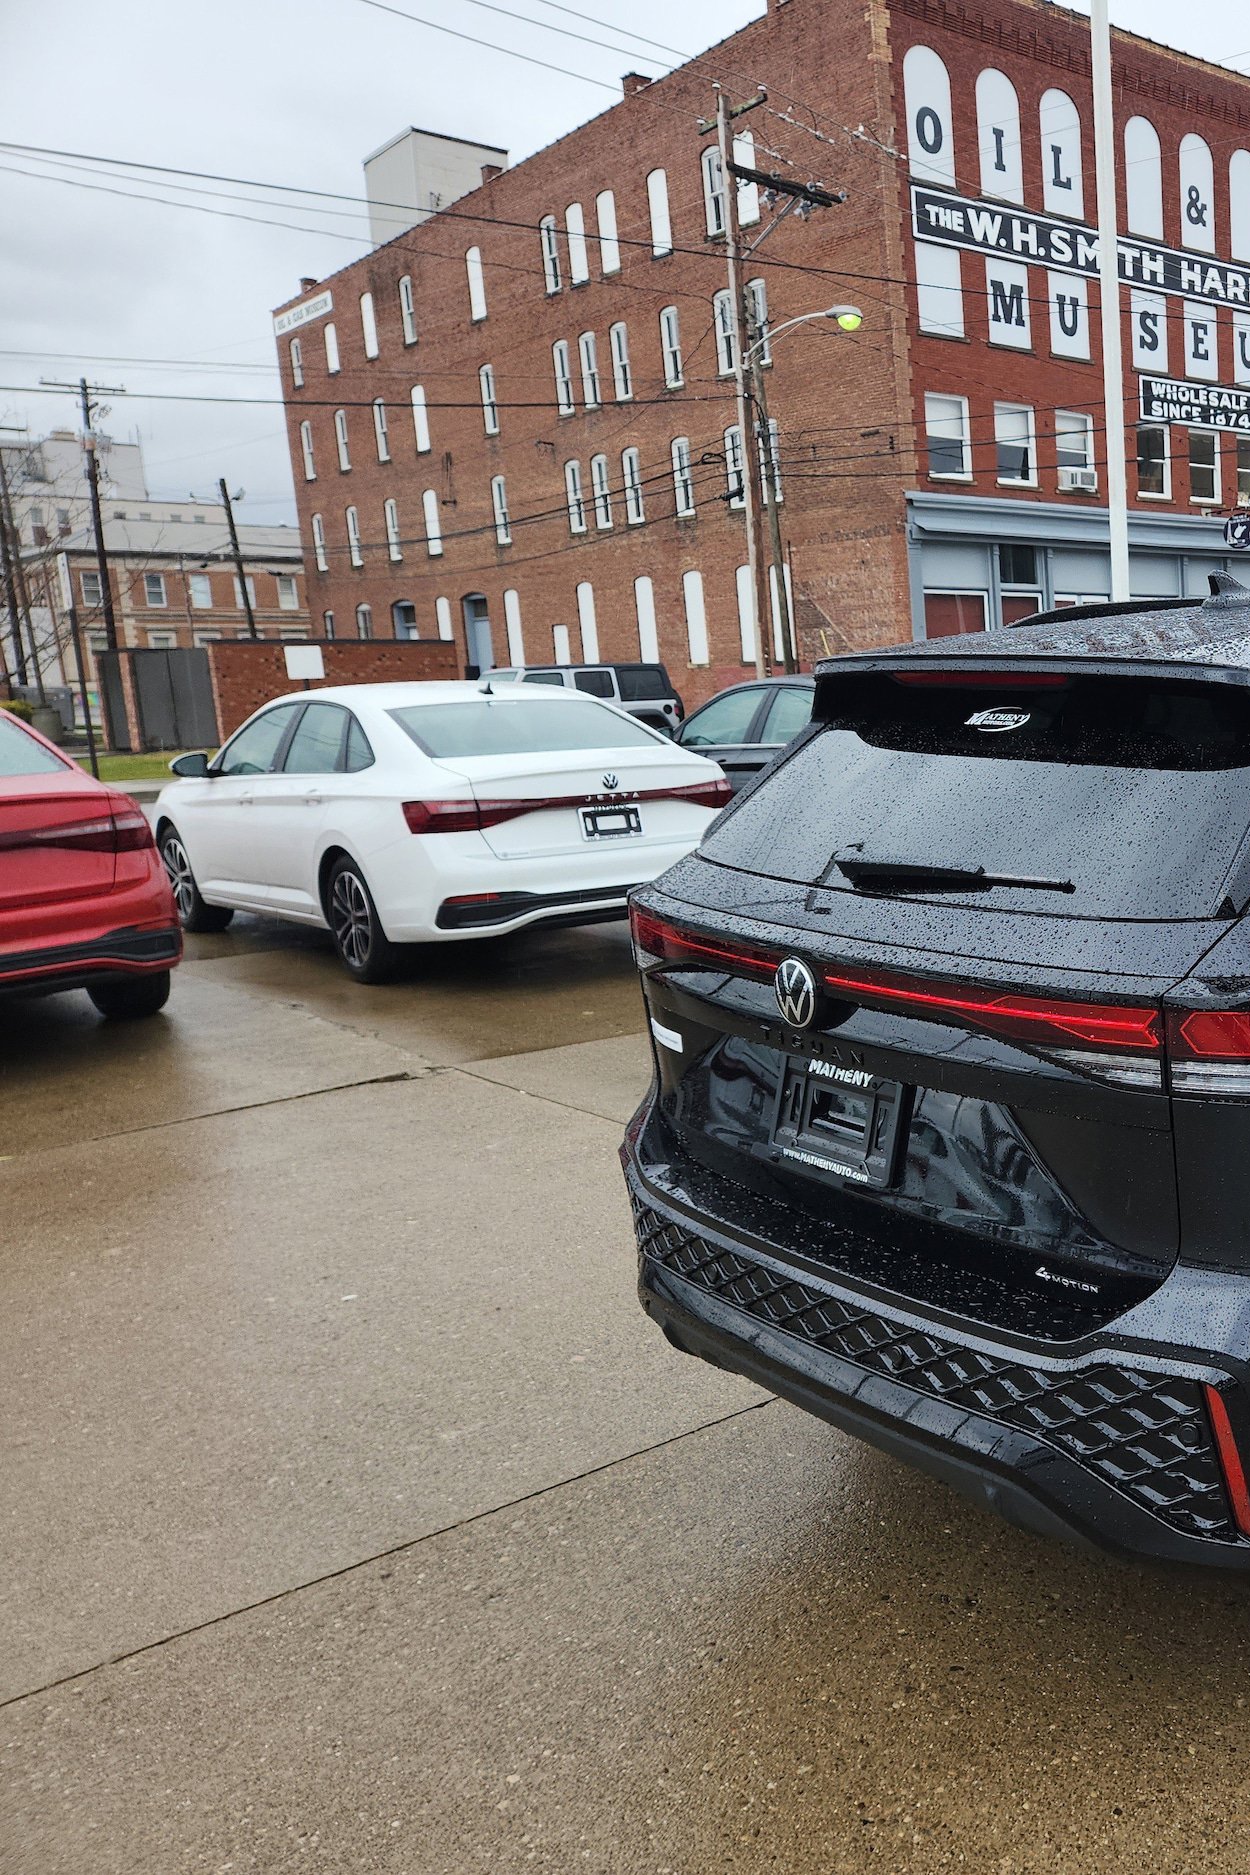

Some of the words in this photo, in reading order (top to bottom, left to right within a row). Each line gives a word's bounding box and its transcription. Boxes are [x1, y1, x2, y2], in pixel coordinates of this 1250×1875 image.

[924, 203, 965, 233] THE
[1150, 381, 1249, 411] WHOLESALE
[1151, 400, 1202, 422] SINCE
[964, 712, 1030, 725] MATHENY
[759, 1024, 865, 1066] TIGUAN
[808, 1058, 874, 1088] MATHENY
